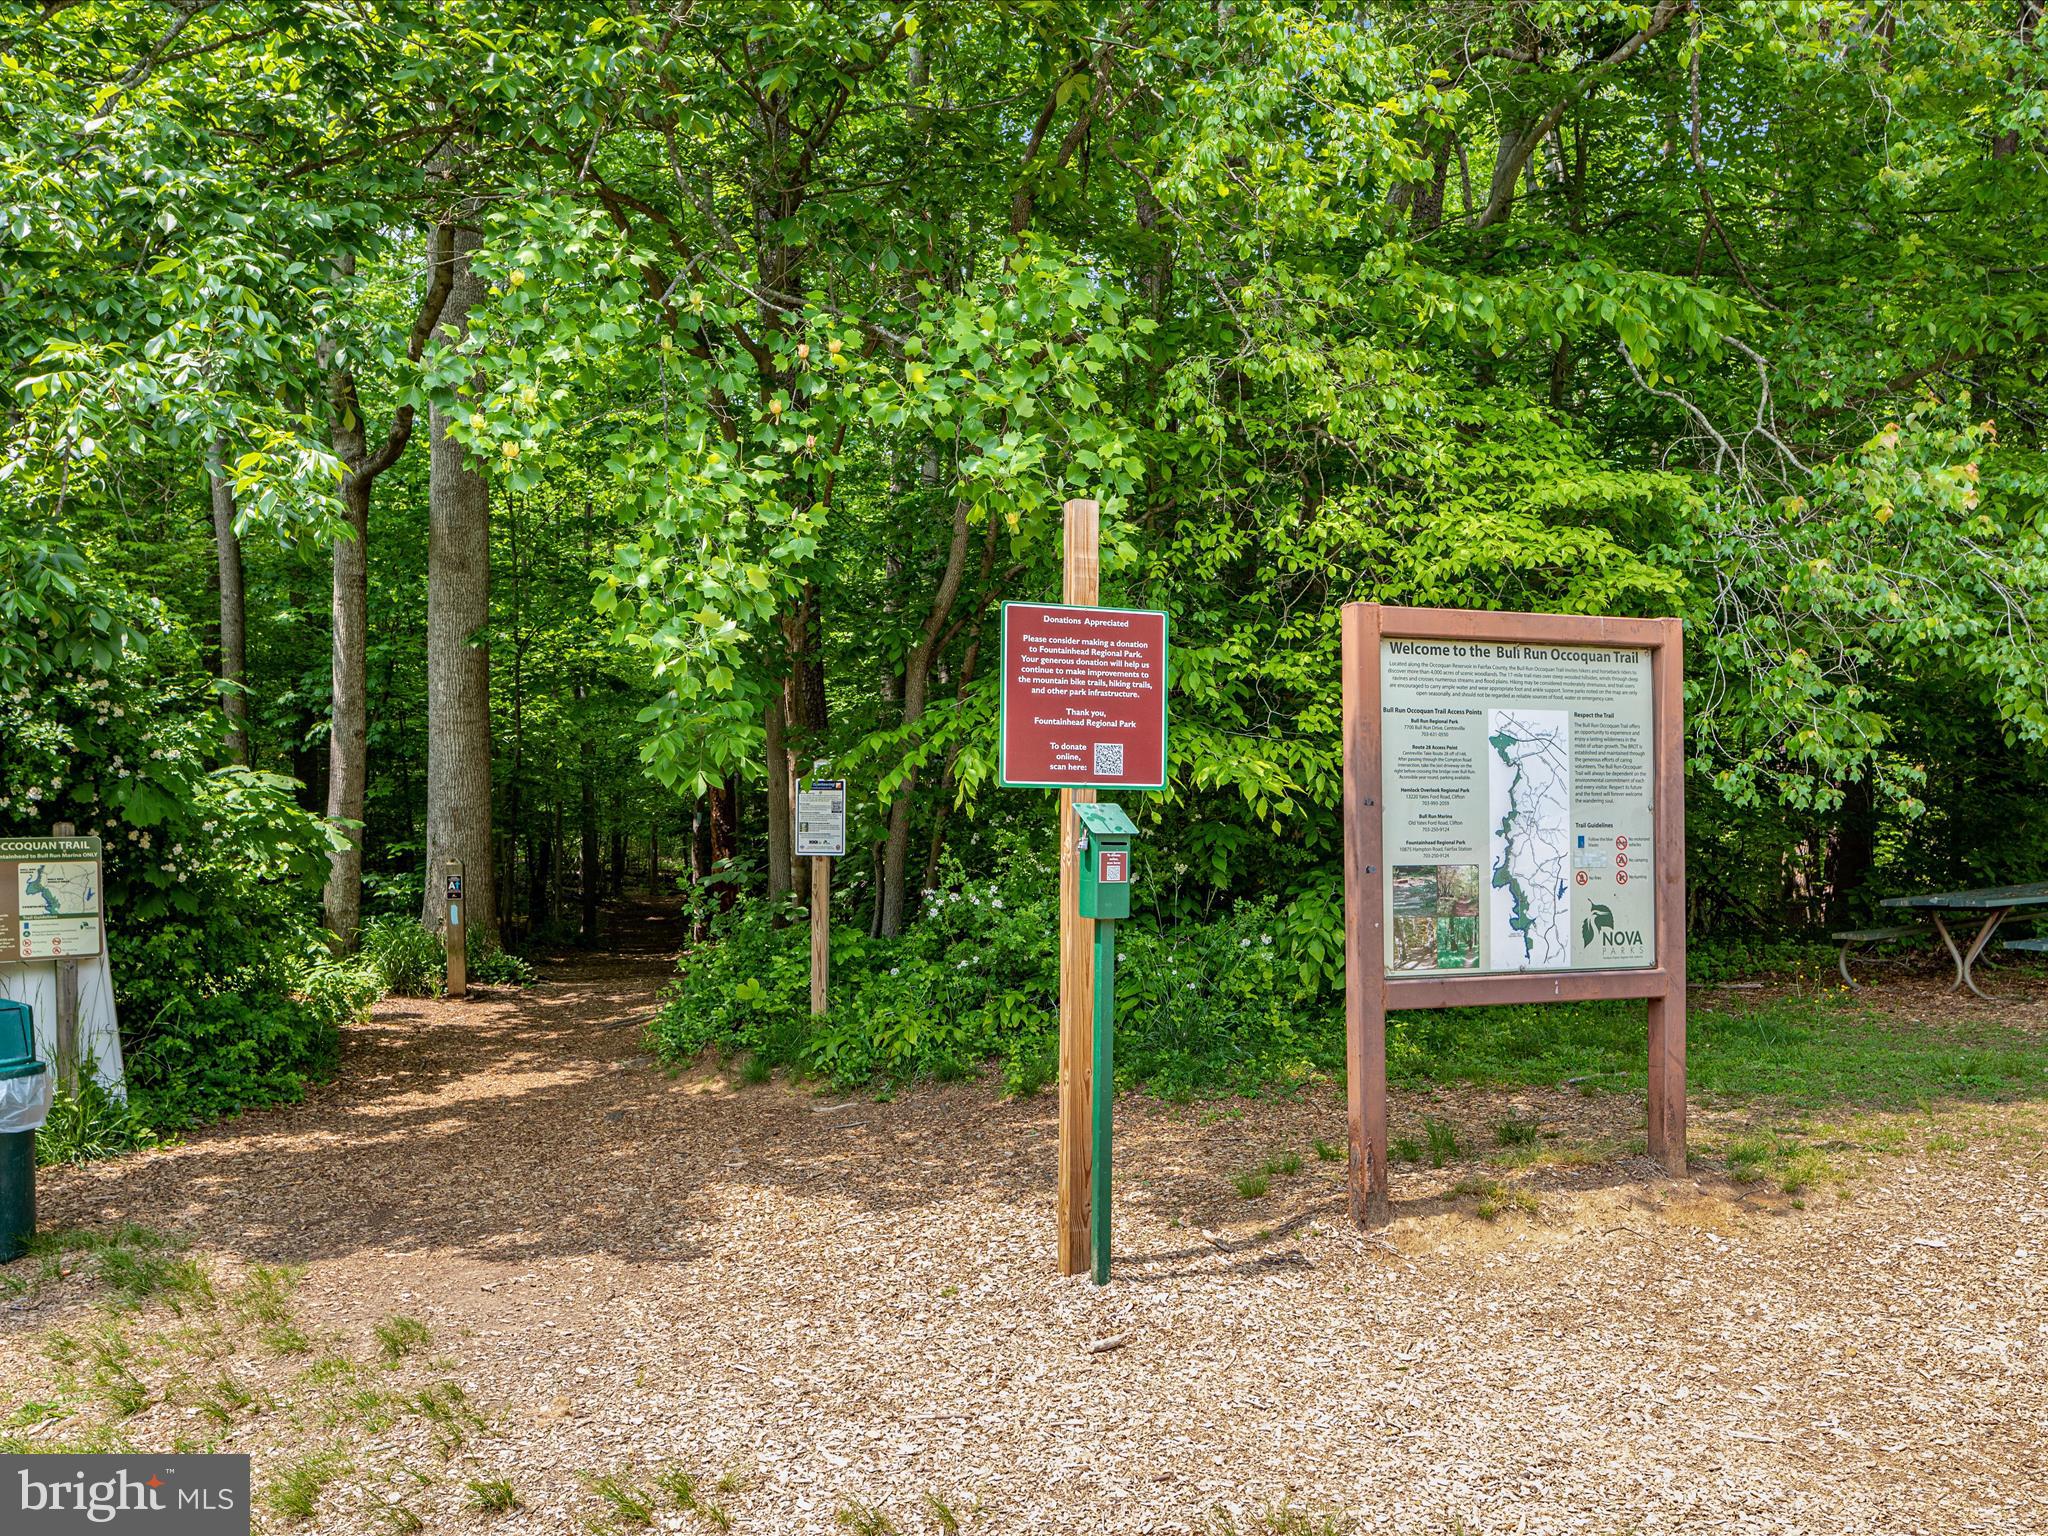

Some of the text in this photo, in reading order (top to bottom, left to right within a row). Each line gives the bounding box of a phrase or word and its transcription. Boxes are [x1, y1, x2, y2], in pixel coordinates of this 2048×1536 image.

[1043, 615, 1129, 628] Donations Appreciated
[1023, 634, 1047, 642] Please
[1048, 636, 1080, 644] consider
[1081, 638, 1109, 647] making
[1116, 640, 1148, 648] donation
[1039, 646, 1090, 655] Fountainhead
[1091, 648, 1123, 658] Regional
[1389, 641, 1450, 656] Welcome
[1453, 645, 1466, 657] to
[1470, 645, 1491, 658] the
[1524, 647, 1547, 660] Run
[1551, 648, 1611, 664] Occoquan
[1613, 651, 1639, 664] Trail
[1040, 657, 1075, 665] generous
[1076, 658, 1109, 666] donation
[1124, 660, 1140, 669] help
[1070, 677, 1086, 685] bike
[1087, 678, 1107, 686] trails,
[1108, 679, 1131, 688] hiking
[1069, 688, 1087, 696] park
[1088, 689, 1140, 697] infrastructure.
[1034, 717, 1085, 725] Fountainhead
[1086, 719, 1118, 728] Regional
[0, 841, 90, 851] CCOQUAN TRAIL
[1602, 930, 1643, 946] NOVA
[1602, 946, 1645, 955] PARKS
